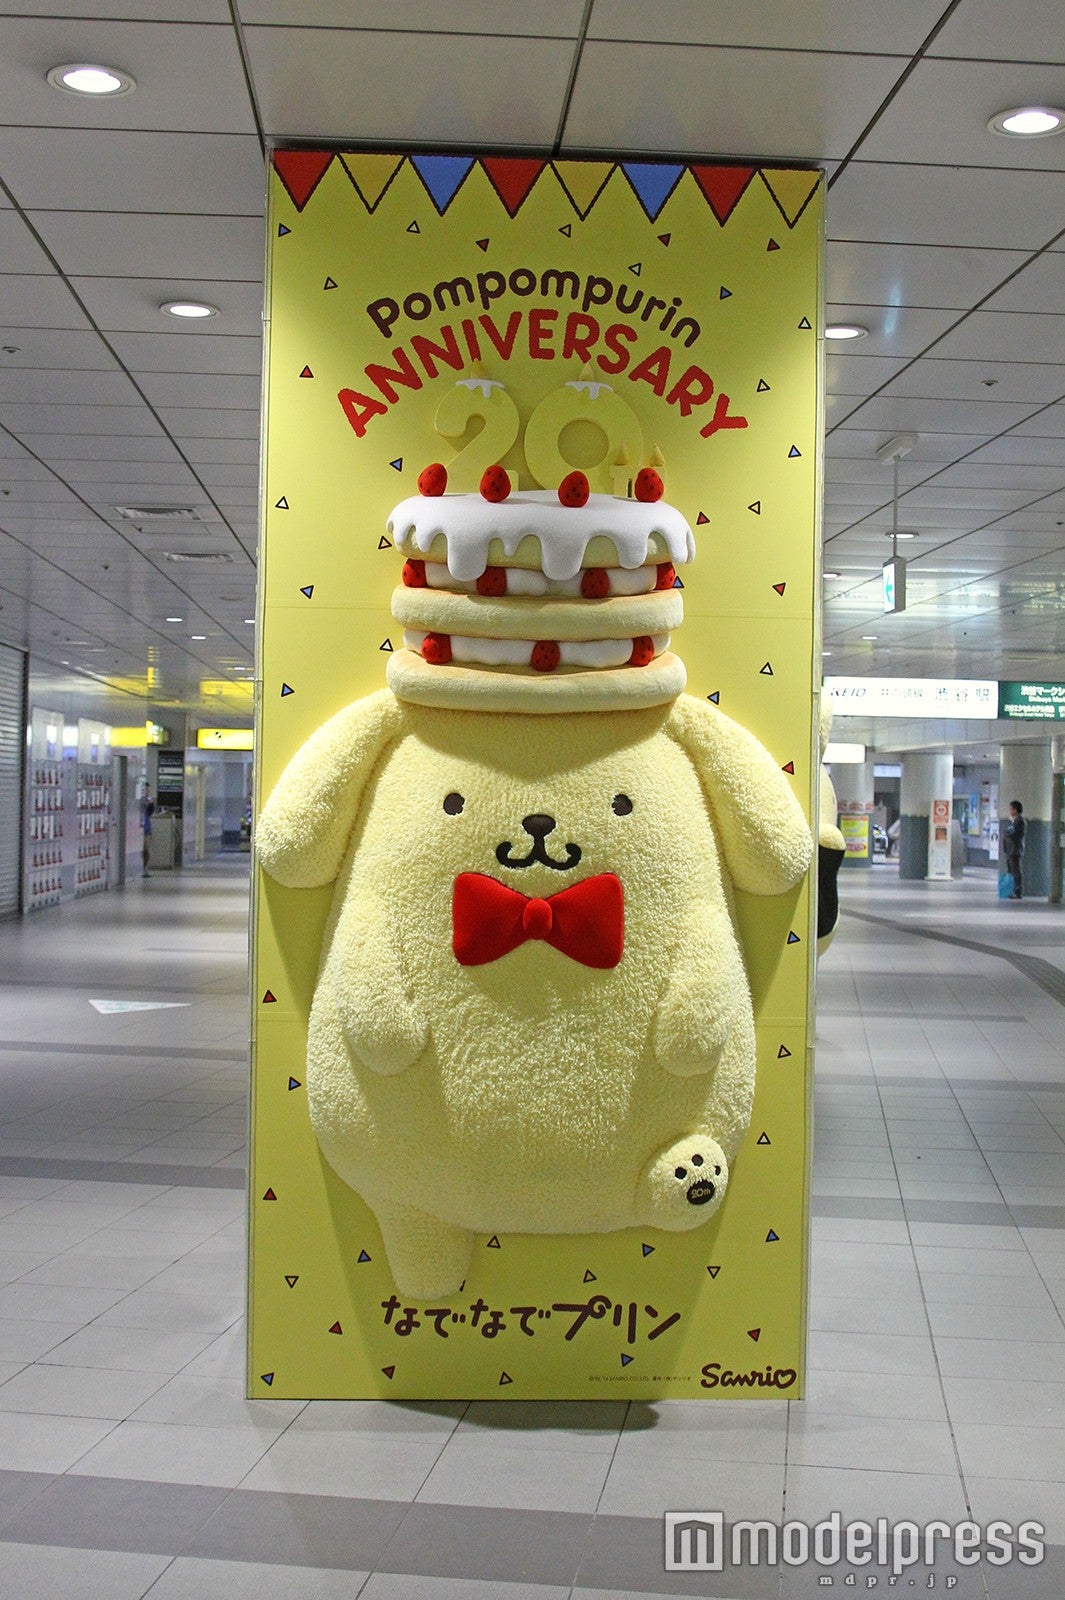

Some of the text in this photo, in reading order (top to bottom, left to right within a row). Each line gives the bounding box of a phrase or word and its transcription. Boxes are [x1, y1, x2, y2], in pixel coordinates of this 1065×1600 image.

[366, 267, 701, 347] Pompompurin
[338, 310, 749, 438] ANNIVERSARY
[830, 687, 867, 698] KEIO
[691, 1188, 710, 1198] 20th
[380, 1294, 682, 1345] なでなでプリン
[700, 1362, 797, 1389] Sanrio
